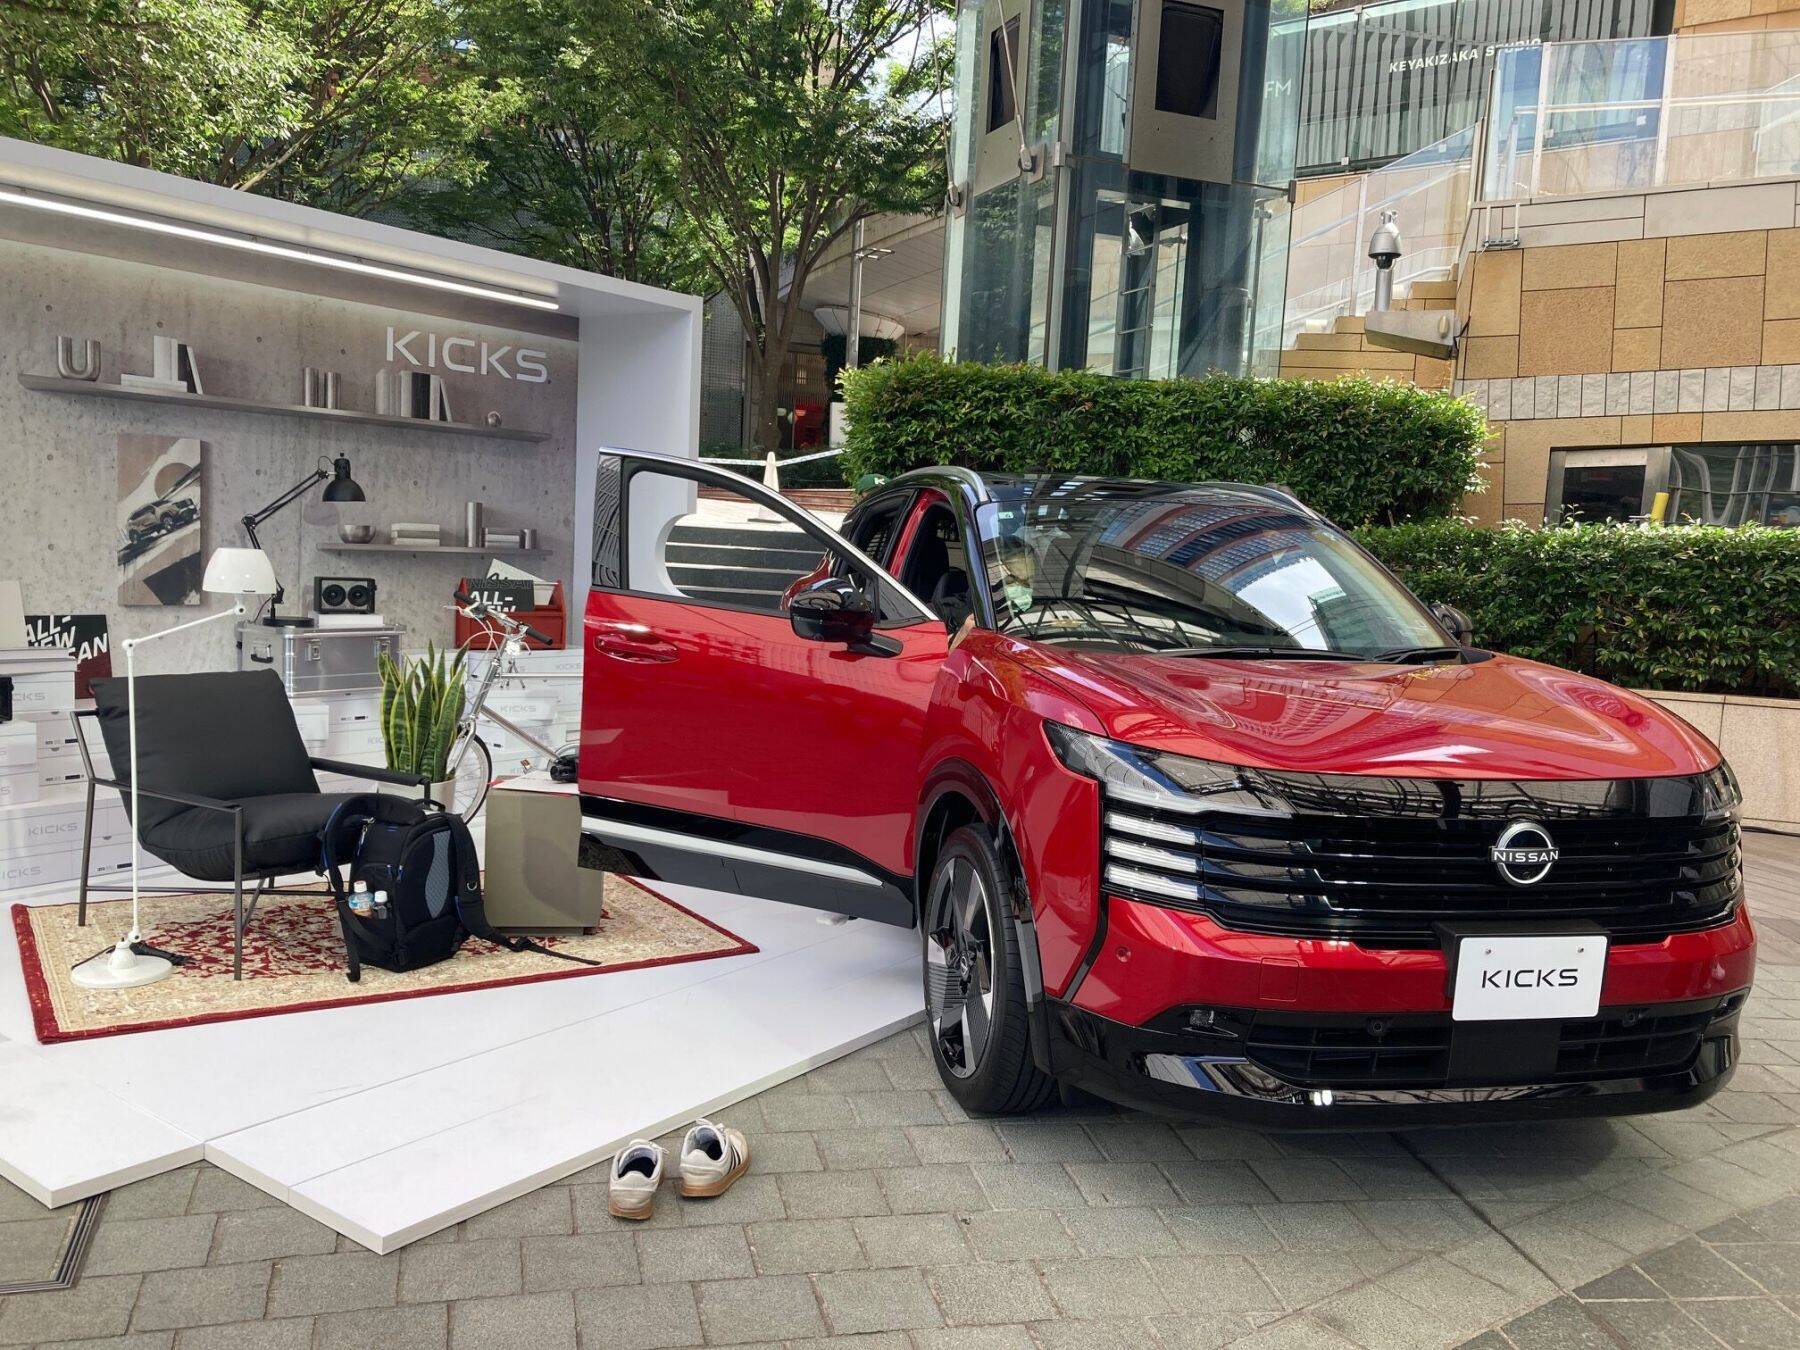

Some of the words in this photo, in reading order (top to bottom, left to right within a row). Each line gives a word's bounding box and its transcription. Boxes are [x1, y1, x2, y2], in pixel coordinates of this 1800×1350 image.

[1389, 49, 1478, 73] KEYAKIZAKA
[1264, 79, 1292, 99] FM
[386, 326, 548, 383] KICKS
[25, 614, 72, 643] ALL-
[28, 823, 78, 836] KICKS
[1493, 851, 1559, 863] NISSAN
[2, 866, 42, 880] ICKS
[1481, 969, 1578, 989] KICKS
